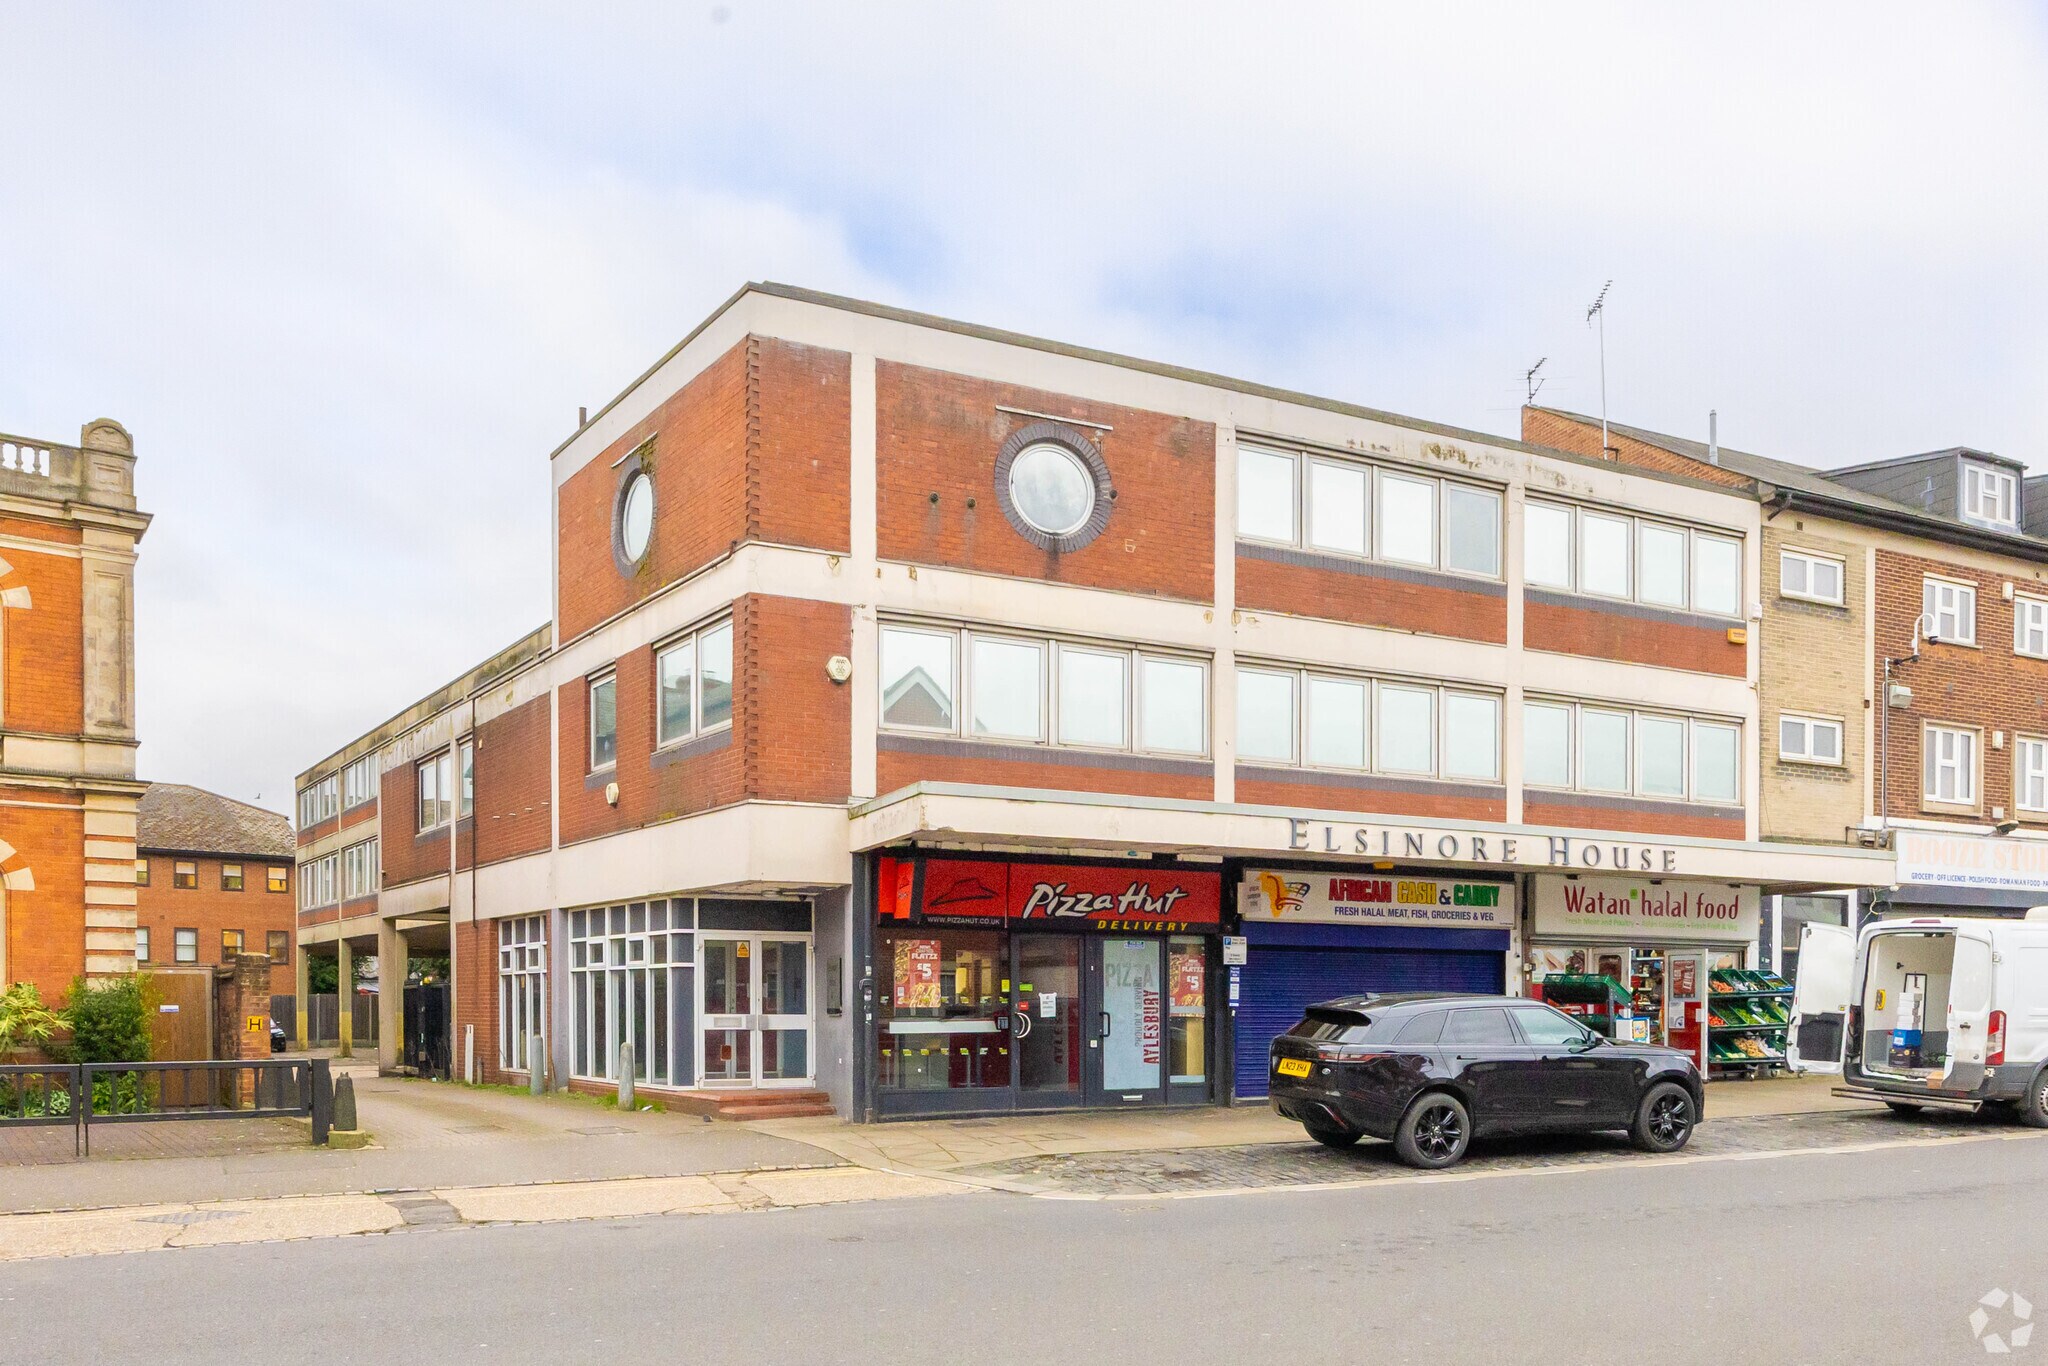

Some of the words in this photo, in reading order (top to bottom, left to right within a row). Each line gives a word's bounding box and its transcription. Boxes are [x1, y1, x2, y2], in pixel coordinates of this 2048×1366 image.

[1289, 818, 1517, 862] ELSINORE
[1549, 836, 1676, 872] HOUSE
[1906, 836, 1986, 869] BOOZE
[1911, 872, 1934, 881] GROCERY
[1022, 881, 1114, 919] Pizza
[1118, 881, 1189, 915] Hut
[1329, 879, 1392, 903] AFRICAN
[1397, 881, 1437, 905] CASH
[1439, 889, 1451, 905] &
[1454, 884, 1500, 907] CARRY
[1564, 885, 1630, 915] Watan
[1641, 889, 1687, 918] halal
[1696, 893, 1739, 920] food
[927, 916, 1000, 925] WWW.PIZZAHUT.CO.UK
[1335, 907, 1359, 916] FRESH
[1361, 908, 1386, 917] HALAL
[1388, 909, 1409, 919] MEAT,
[1411, 909, 1430, 920] FISH,
[1432, 910, 1471, 920] GROCERIES
[1473, 912, 1478, 920] &
[1480, 912, 1494, 921] VEG
[1098, 920, 1188, 931] DELIVERY
[917, 963, 932, 977] £5
[1187, 976, 1199, 990] £5
[250, 1019, 261, 1030] H
[1143, 990, 1159, 1065] AYLESBURY
